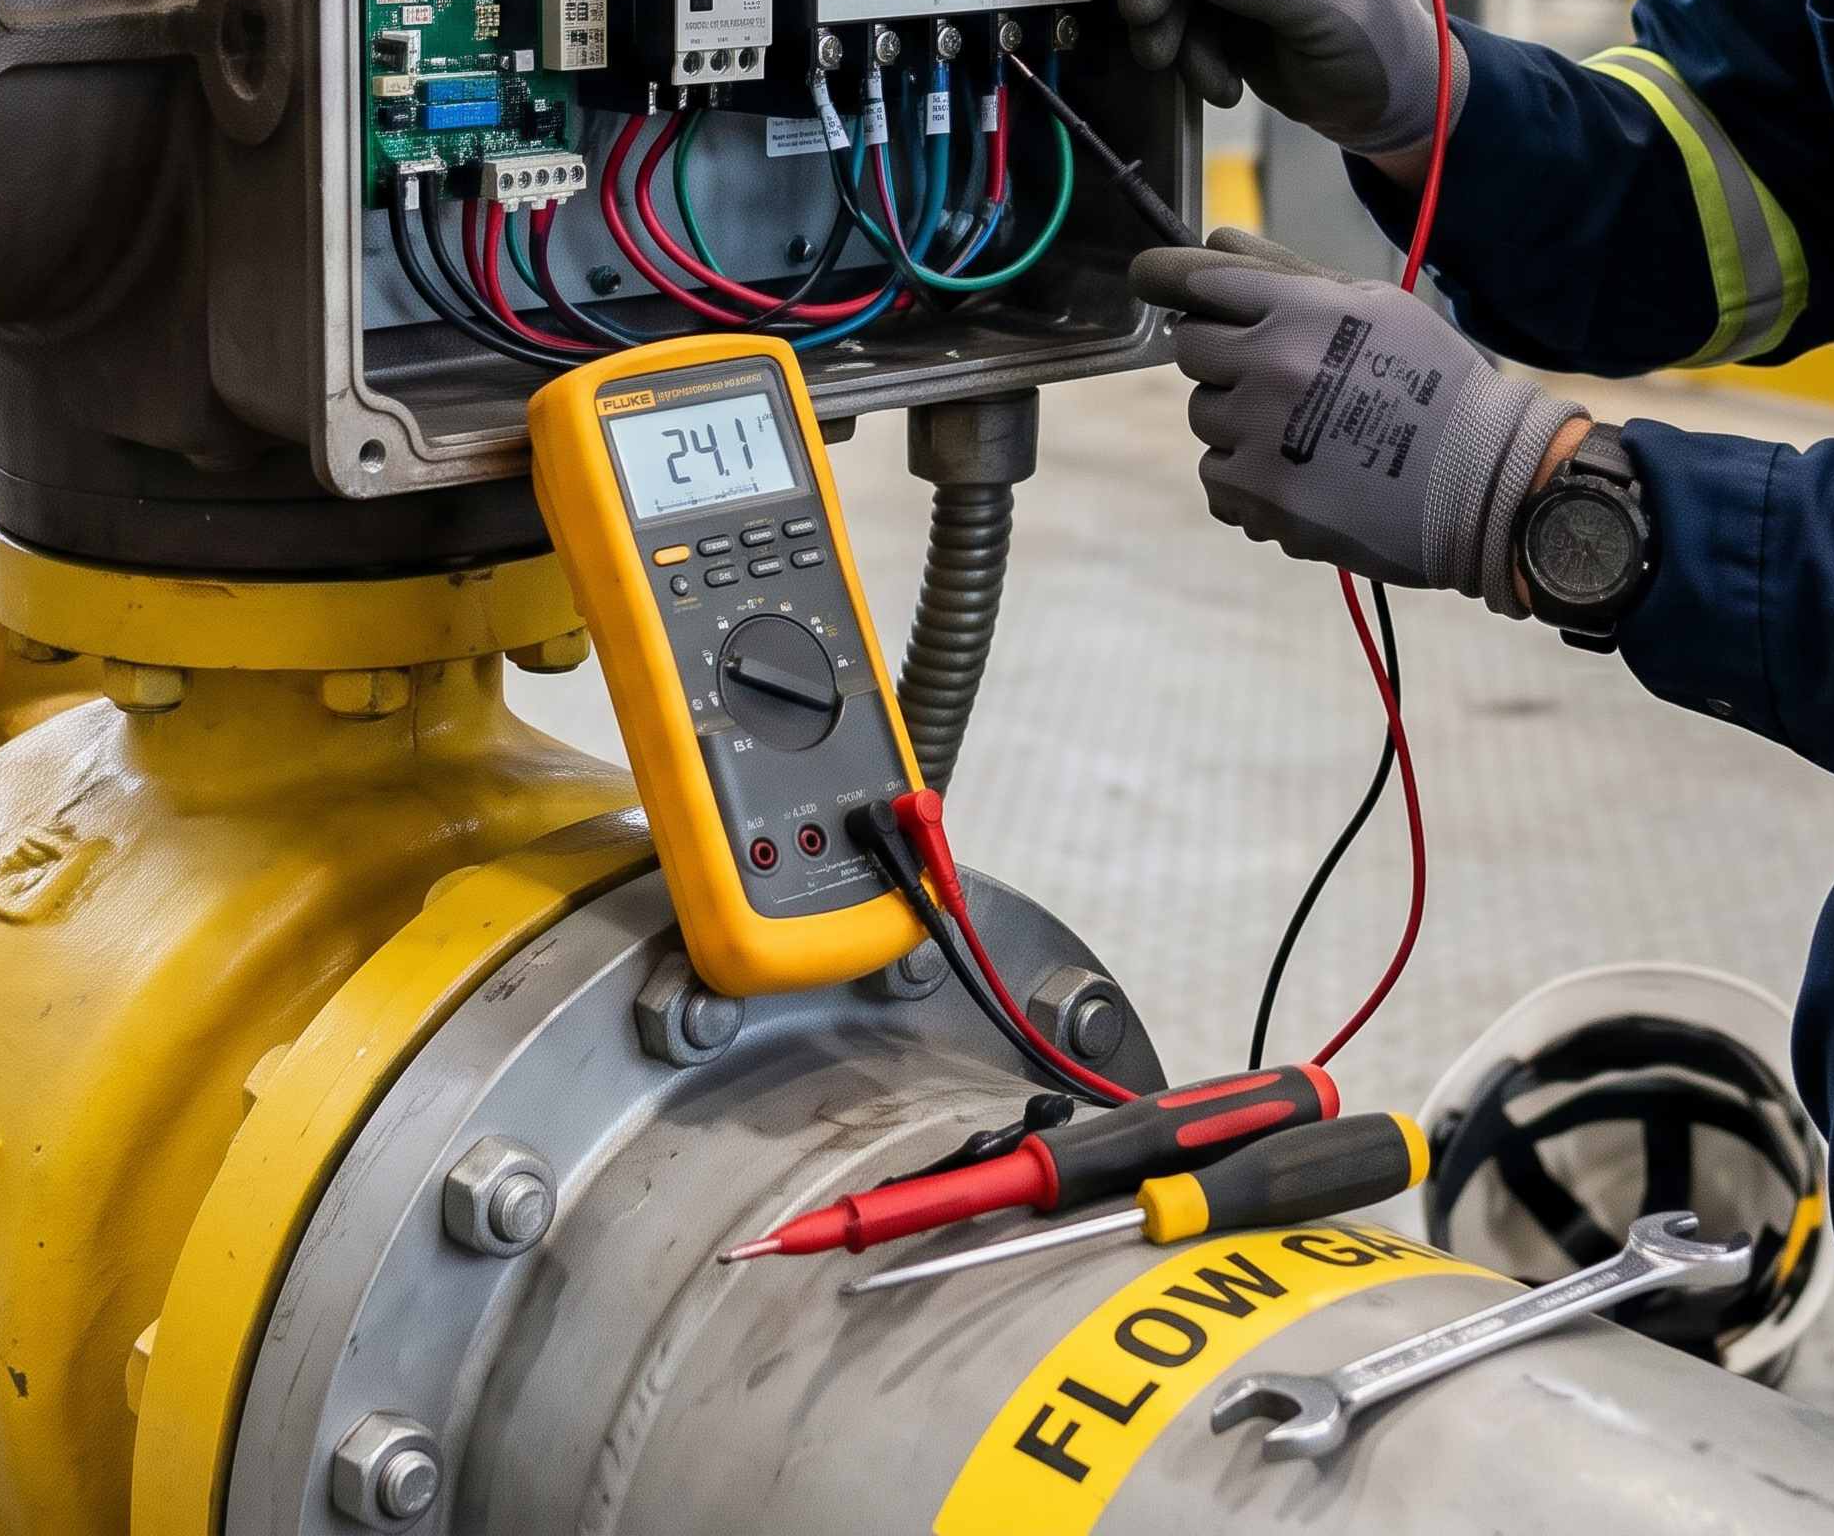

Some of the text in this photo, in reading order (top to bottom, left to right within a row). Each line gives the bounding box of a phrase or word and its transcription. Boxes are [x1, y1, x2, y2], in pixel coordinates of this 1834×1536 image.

[602, 394, 652, 412] FLUKE
[661, 417, 754, 485] 24.1
[1013, 1251, 1289, 1484] FLOW
[1280, 1225, 1462, 1268] GA
